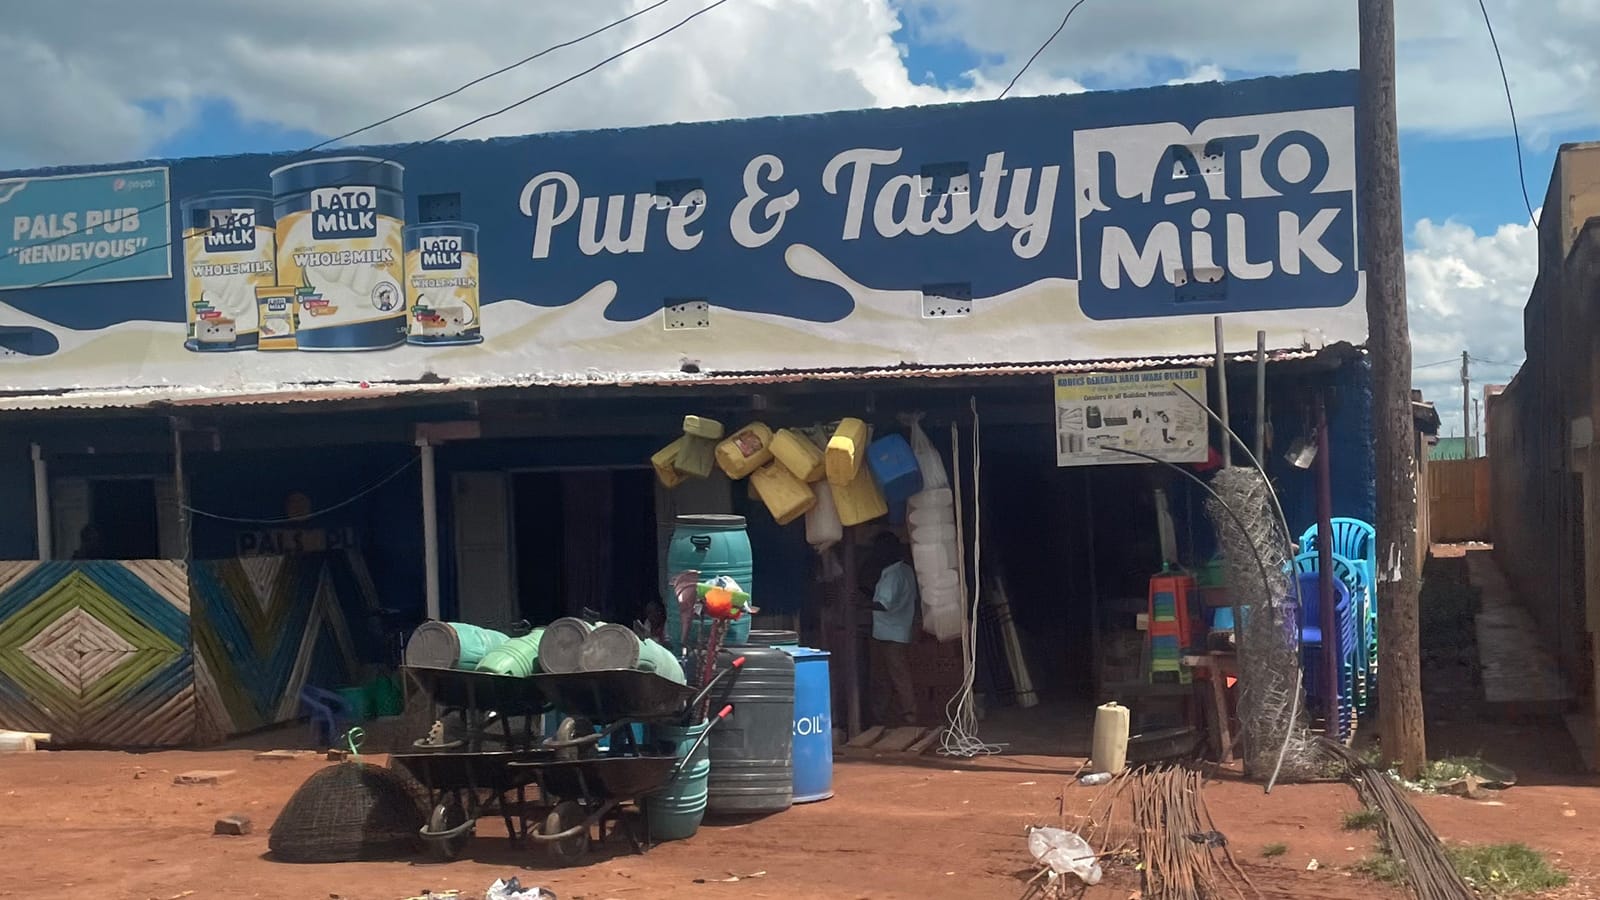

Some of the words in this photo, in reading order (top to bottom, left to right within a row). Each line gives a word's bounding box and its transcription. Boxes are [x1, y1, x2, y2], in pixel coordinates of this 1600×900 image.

[1098, 130, 1330, 206] LATO
[316, 190, 372, 210] LATO
[518, 171, 707, 259] Pure
[729, 154, 800, 249] &
[822, 146, 1060, 260] Tasty
[13, 212, 78, 241] PALS
[85, 207, 140, 235] PUB
[7, 237, 149, 265] "RENDEVOUS"
[423, 239, 459, 251] LATO
[292, 251, 352, 268] WHOLE
[352, 248, 394, 264] MILK
[192, 264, 240, 278] WHOLE
[239, 261, 274, 274] MILK
[411, 278, 449, 289] WHOLE
[448, 276, 477, 289] MILK
[1086, 374, 1118, 386] GENERAL
